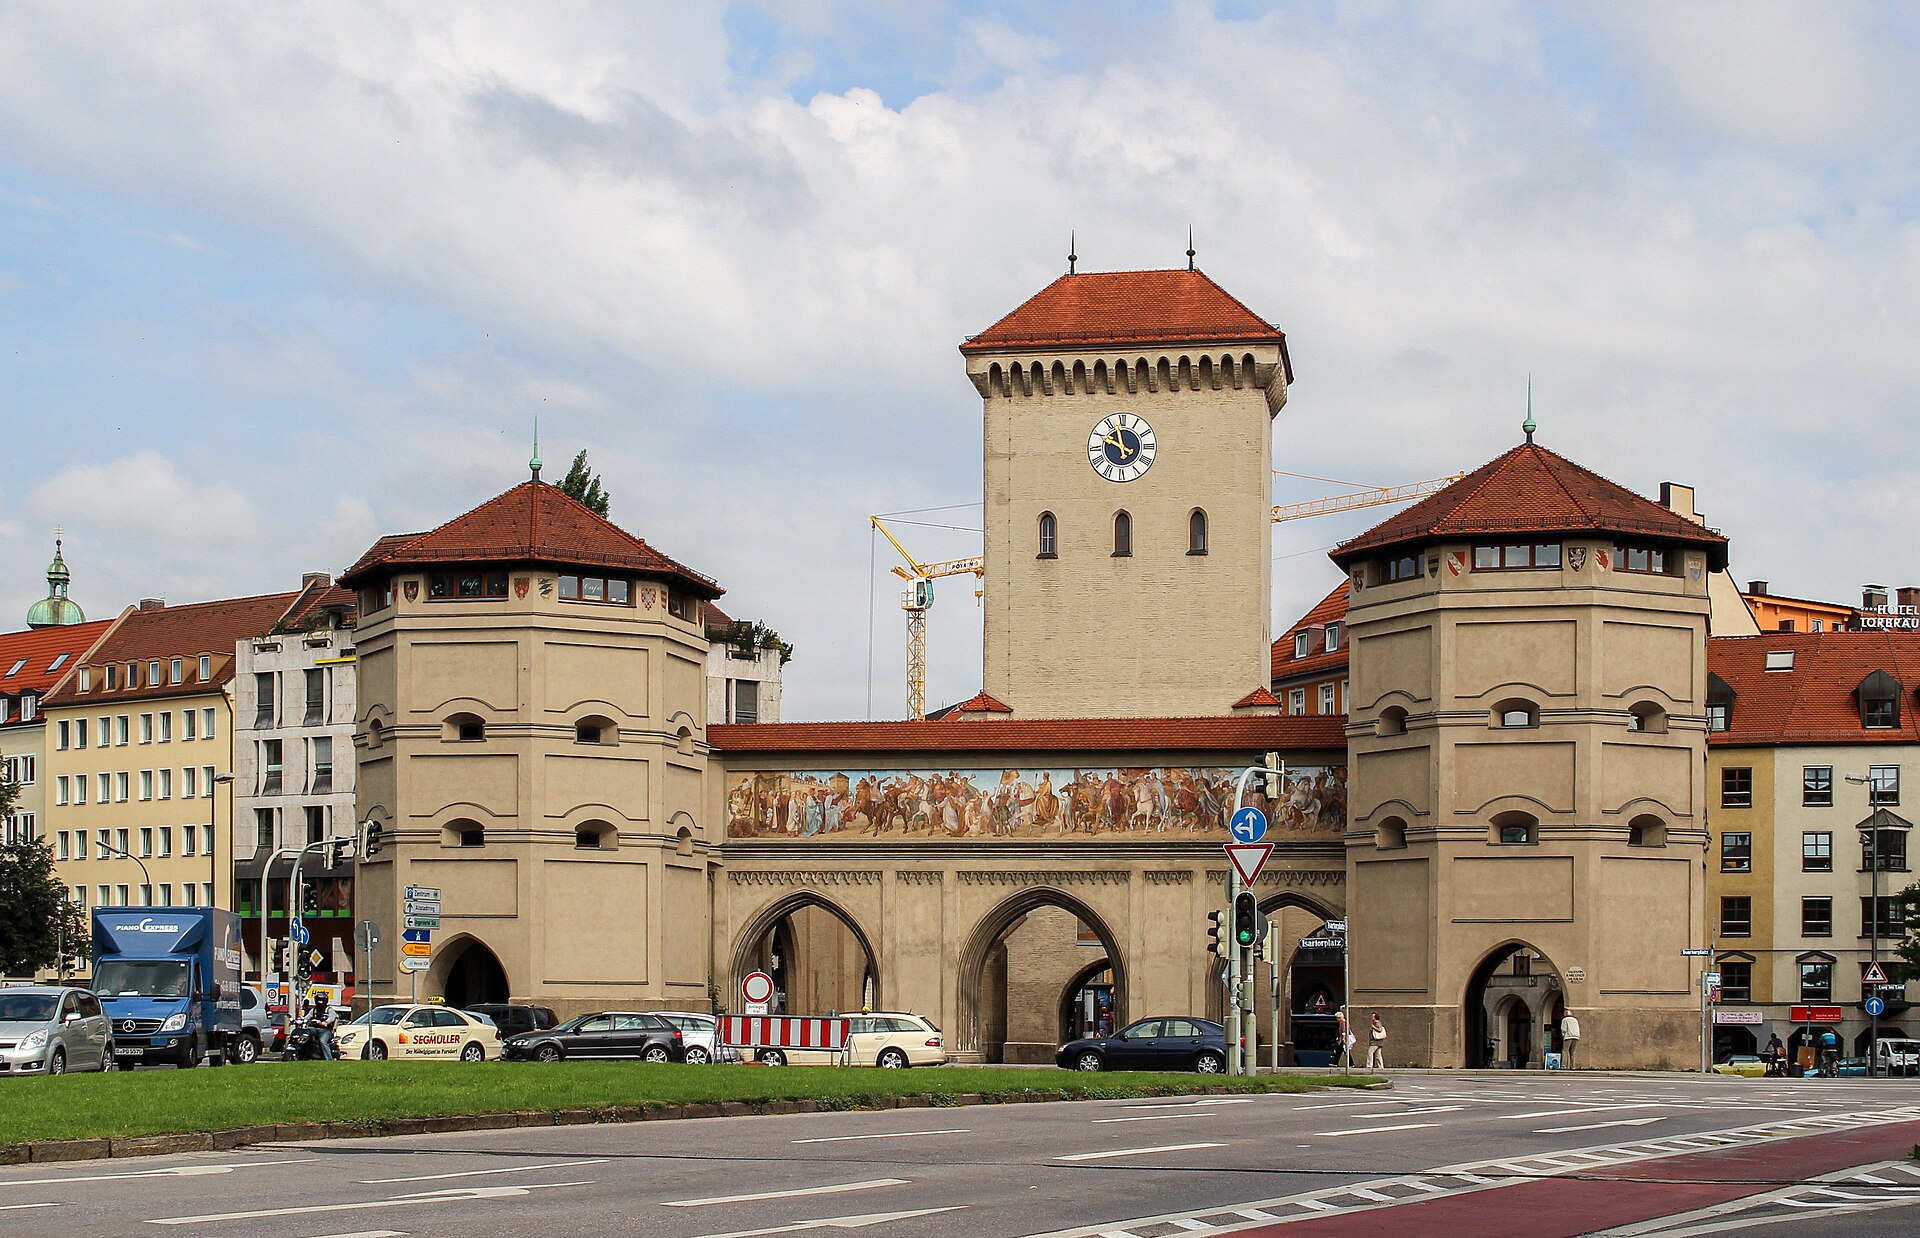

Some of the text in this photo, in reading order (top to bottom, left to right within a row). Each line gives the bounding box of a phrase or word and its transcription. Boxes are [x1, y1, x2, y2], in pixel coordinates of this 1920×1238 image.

[1877, 604, 1920, 615] HOTEL
[1860, 617, 1919, 628] TORBRÄU
[1302, 939, 1341, 948] Isartorplatz
[412, 1034, 461, 1045] SEGMÜLLER
